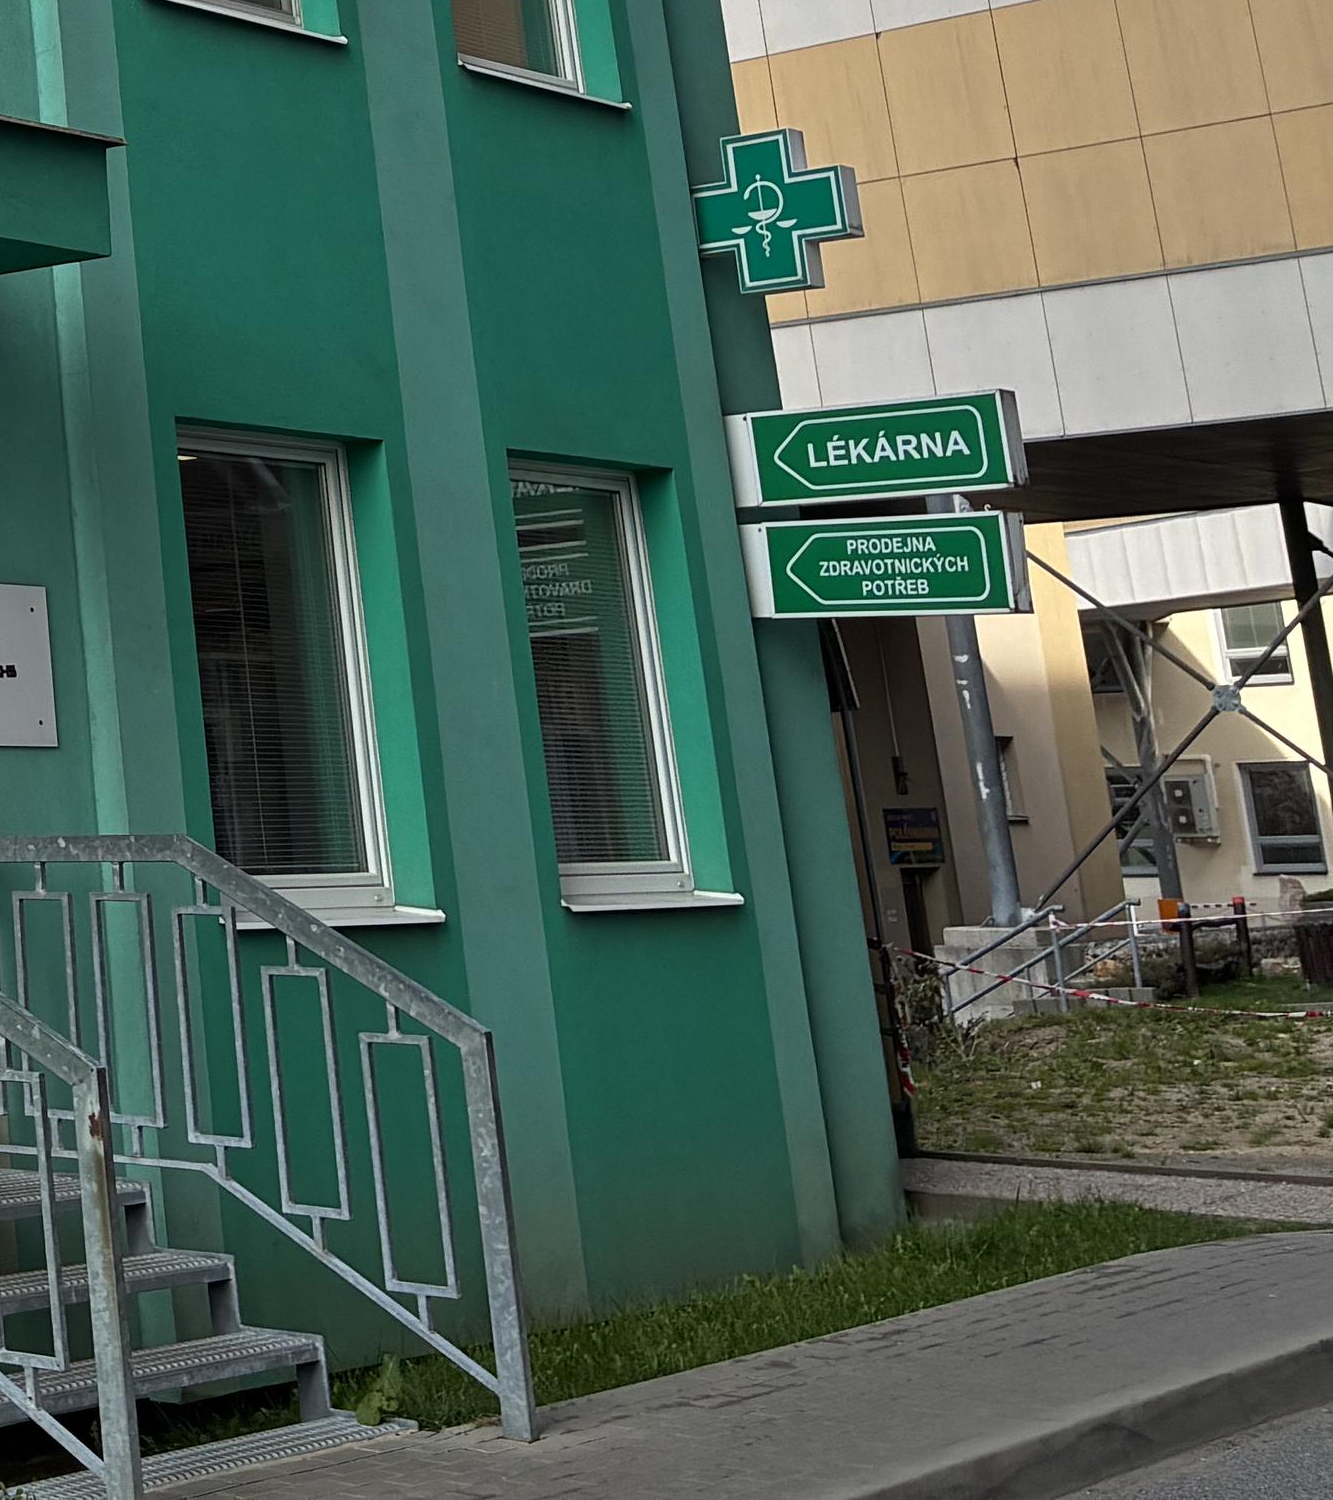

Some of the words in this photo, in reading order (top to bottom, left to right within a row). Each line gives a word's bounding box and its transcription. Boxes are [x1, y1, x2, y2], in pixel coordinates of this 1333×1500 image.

[807, 430, 971, 468] LÉKÁRNA
[846, 536, 936, 555] PRODEJNA
[819, 553, 969, 577] ZDRAVOTNICKÝCH
[862, 576, 930, 596] POTŘEB
